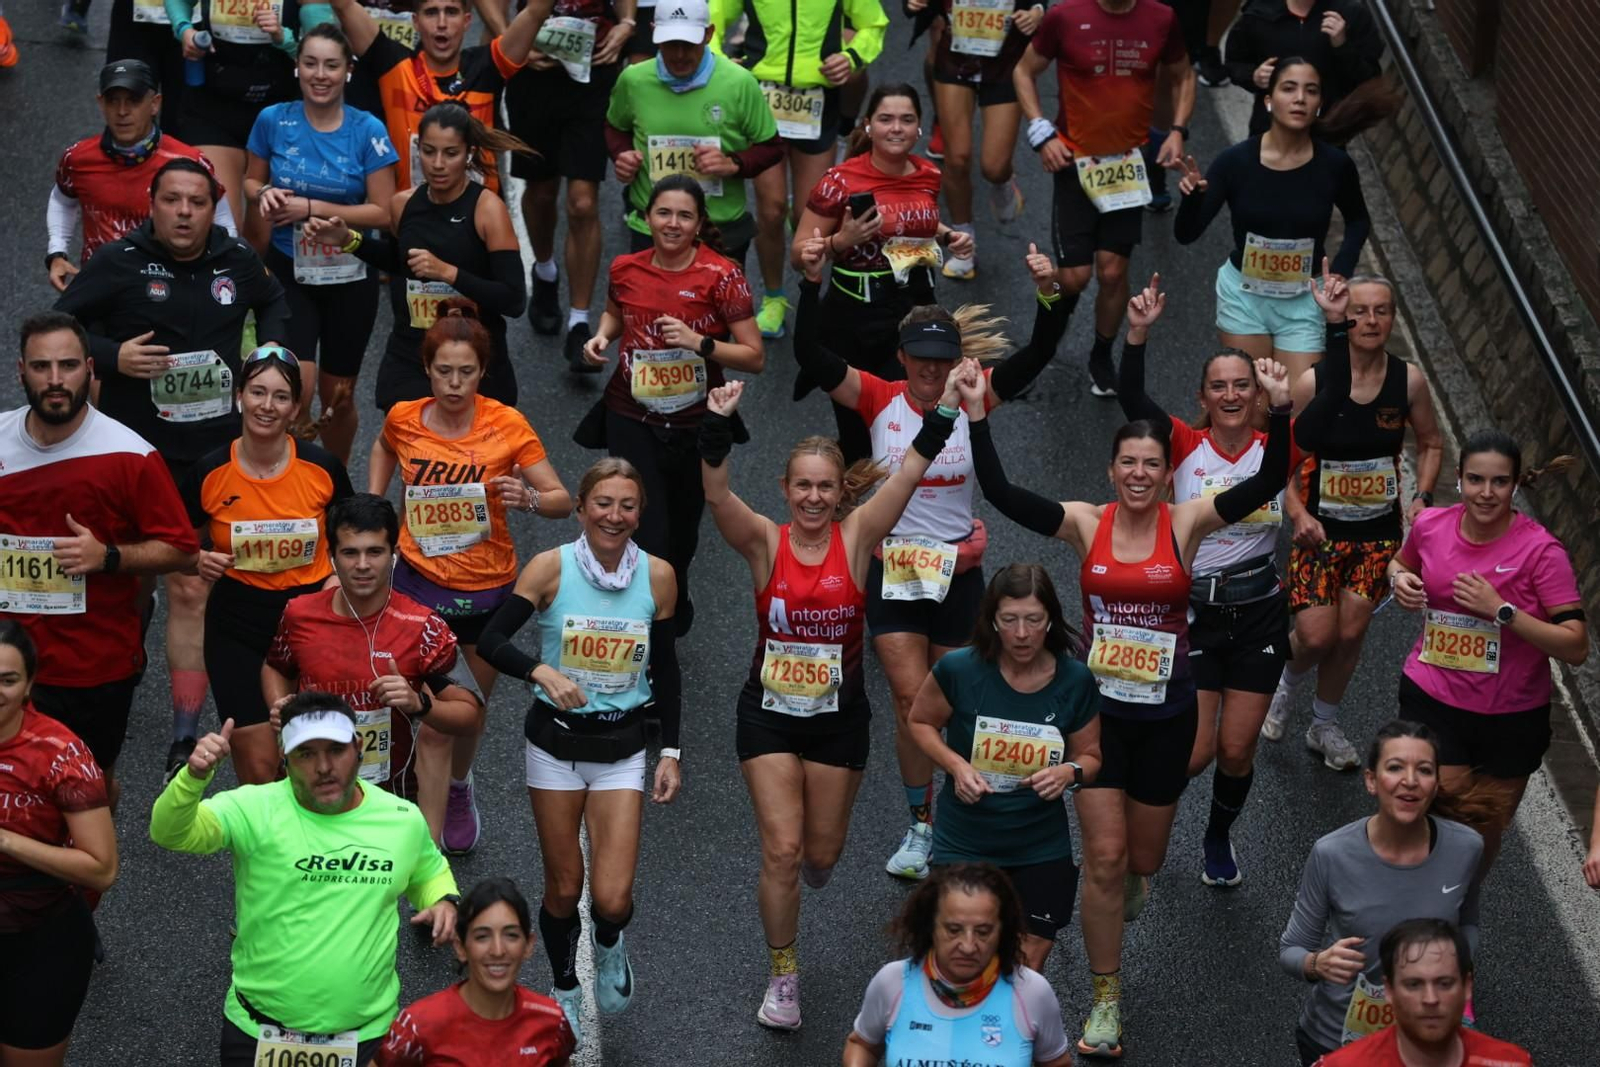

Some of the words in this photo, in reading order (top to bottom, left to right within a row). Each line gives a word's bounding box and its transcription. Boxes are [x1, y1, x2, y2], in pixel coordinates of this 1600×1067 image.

[956, 10, 1004, 31] 13745
[546, 30, 583, 53] 7755
[765, 92, 813, 114] 13304
[655, 152, 697, 171] 1413
[1085, 164, 1136, 189] 12243
[1250, 251, 1301, 273] 11368
[164, 369, 215, 394] 8744
[639, 364, 694, 386] 13690
[933, 455, 966, 465] VILLA
[410, 458, 487, 486] 7RUN
[1327, 475, 1386, 496] 10923
[413, 502, 475, 525] 12883
[241, 539, 303, 560] 11169
[888, 552, 942, 571] 14454
[569, 635, 635, 660] 10677
[1429, 628, 1486, 658] 13288
[1098, 644, 1159, 672] 12865
[771, 659, 829, 685] 12656
[982, 738, 1047, 766] 12401
[307, 852, 394, 873] ReVisa
[301, 874, 393, 886] AUTORECAMBIOS
[264, 1048, 340, 1067] 10690
